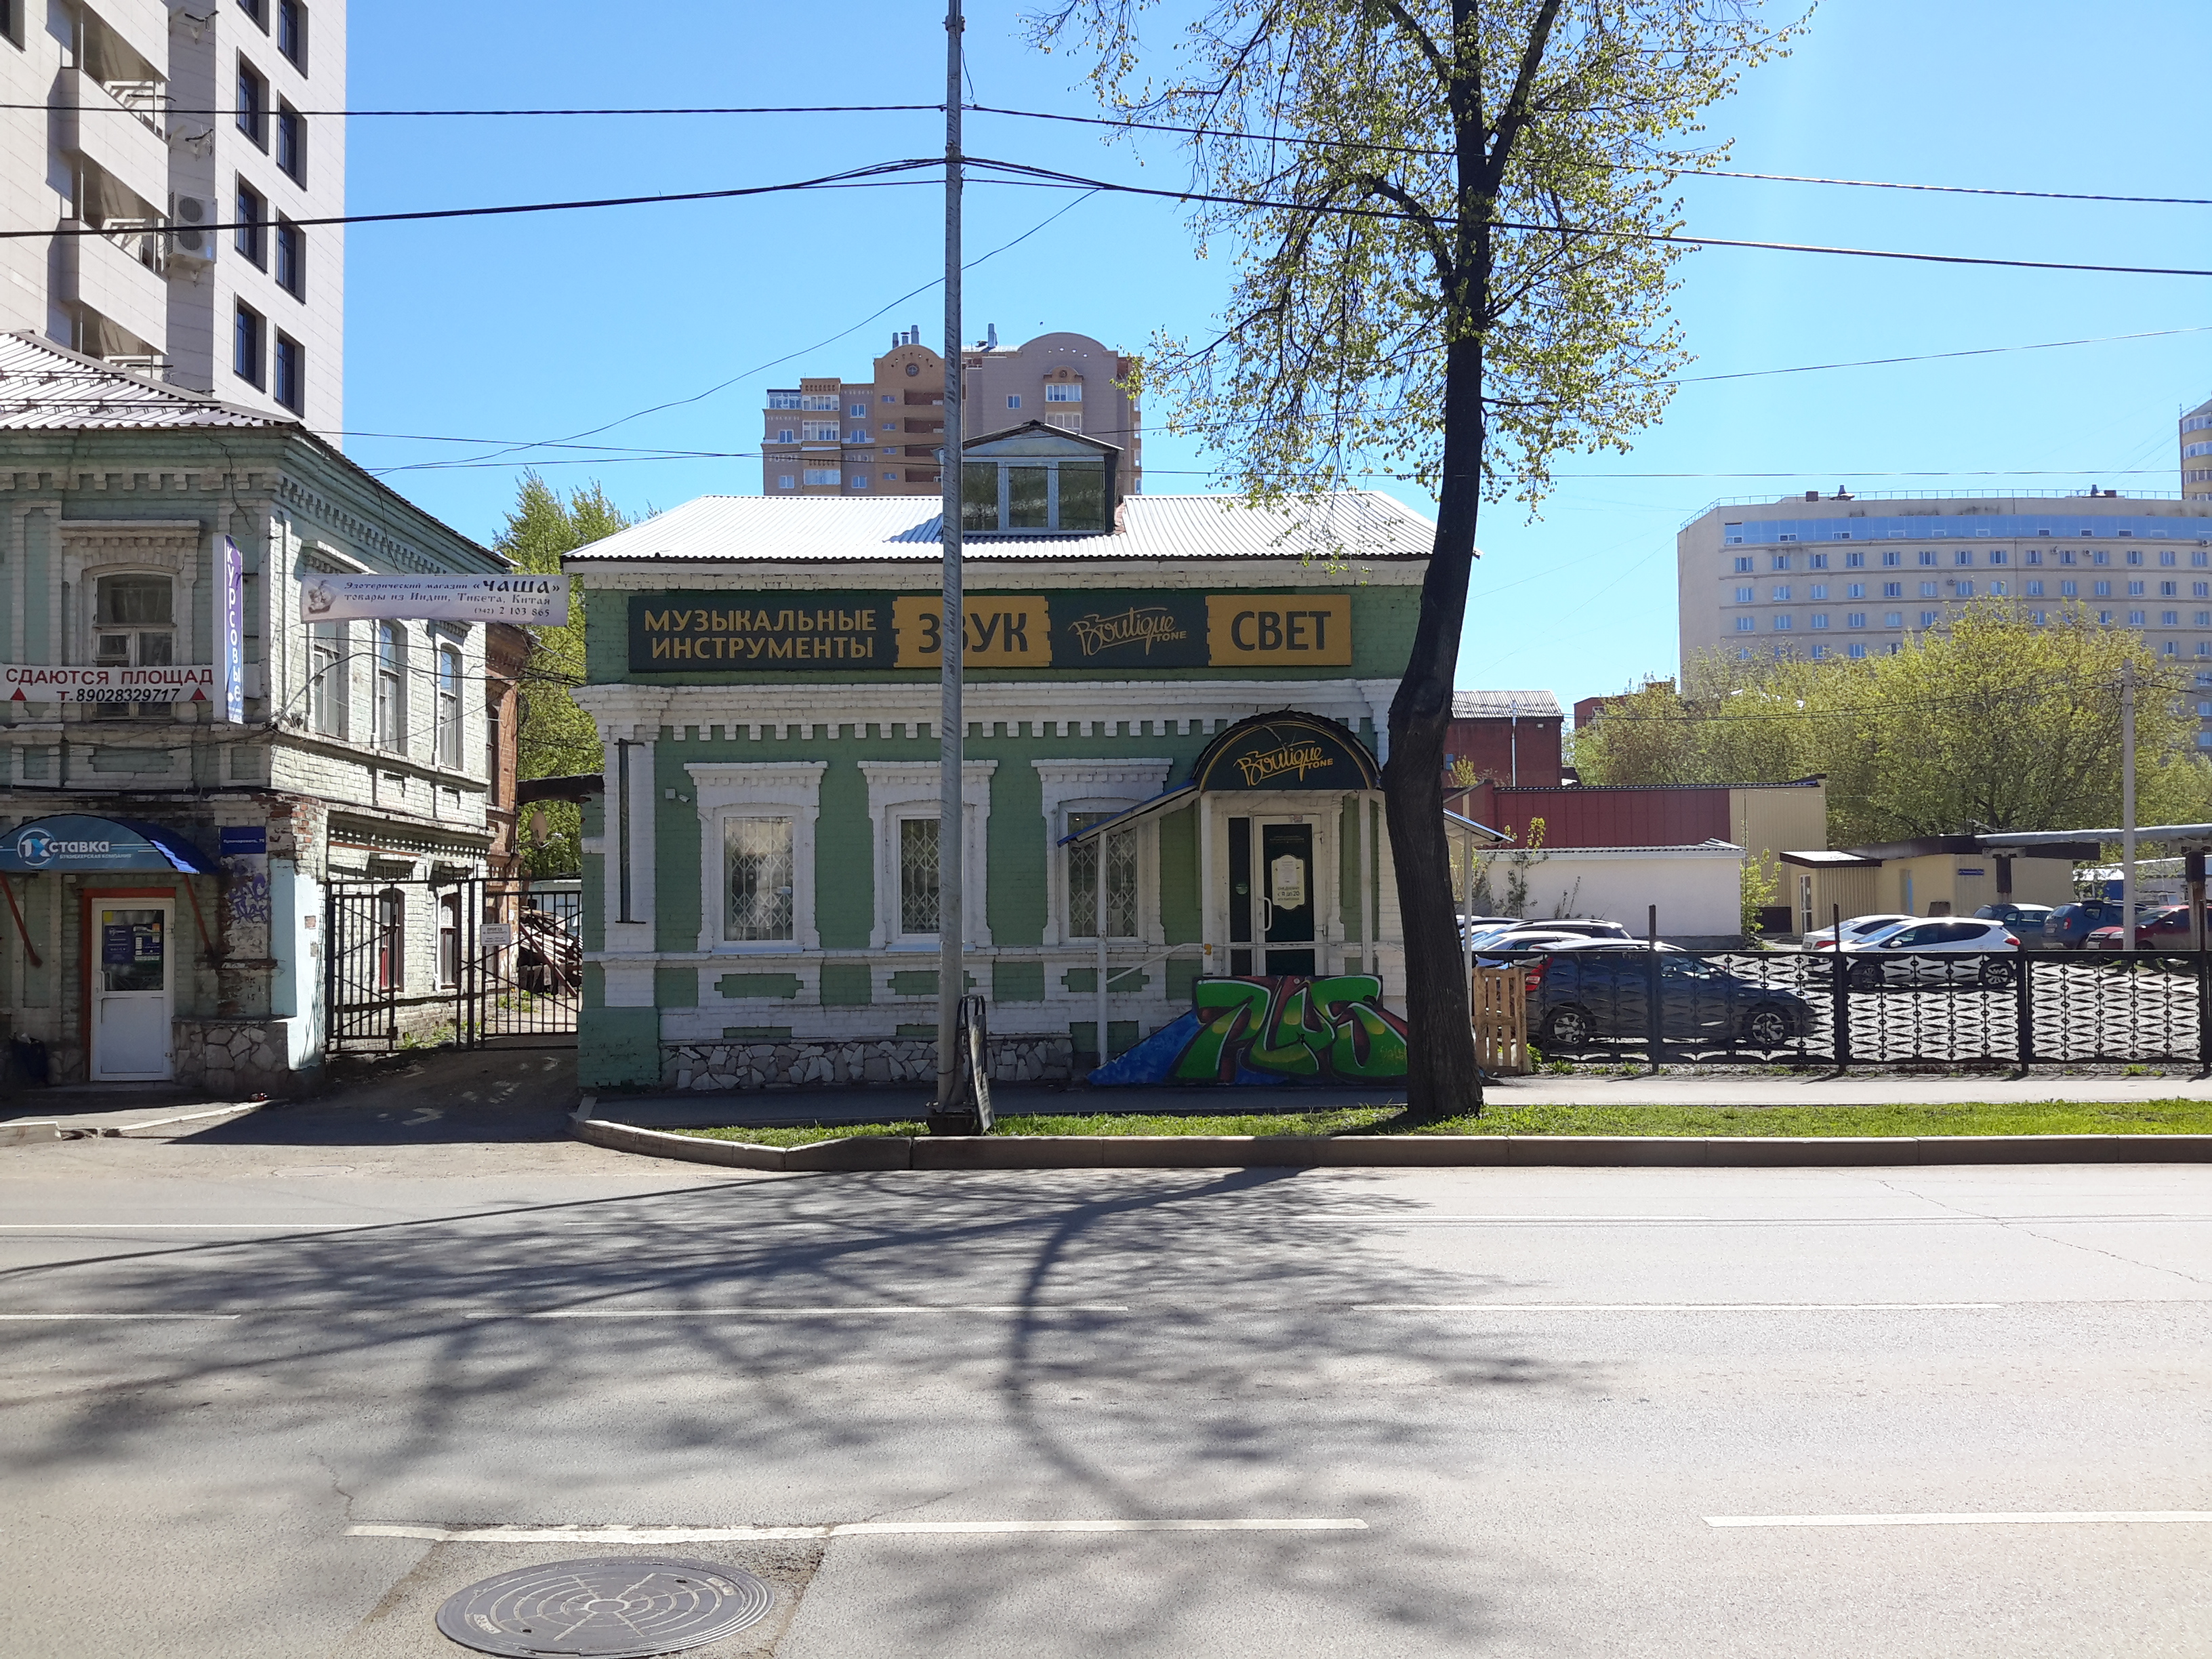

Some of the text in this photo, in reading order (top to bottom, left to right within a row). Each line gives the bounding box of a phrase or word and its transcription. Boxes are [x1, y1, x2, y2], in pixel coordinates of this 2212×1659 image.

[344, 581, 421, 590] Эзотерический
[344, 593, 386, 602] товары
[410, 592, 451, 602] Индии,
[457, 592, 506, 604] Тибета,
[512, 594, 550, 605] Китая
[499, 606, 505, 615] 2
[510, 607, 527, 615] 103
[531, 608, 550, 617] 865
[644, 609, 877, 632] МУЗЫКАЛЬНЫЕ
[1067, 607, 1176, 656] Boutique
[1156, 630, 1187, 642] TONE
[1231, 611, 1331, 651] СВЕТ
[651, 637, 873, 659] ИНСТРУМЕНТЫ
[5, 668, 213, 686] СДАЮТСЯ ПЛОЩАД
[1233, 740, 1323, 787] Boutique
[1307, 758, 1334, 770] TONE
